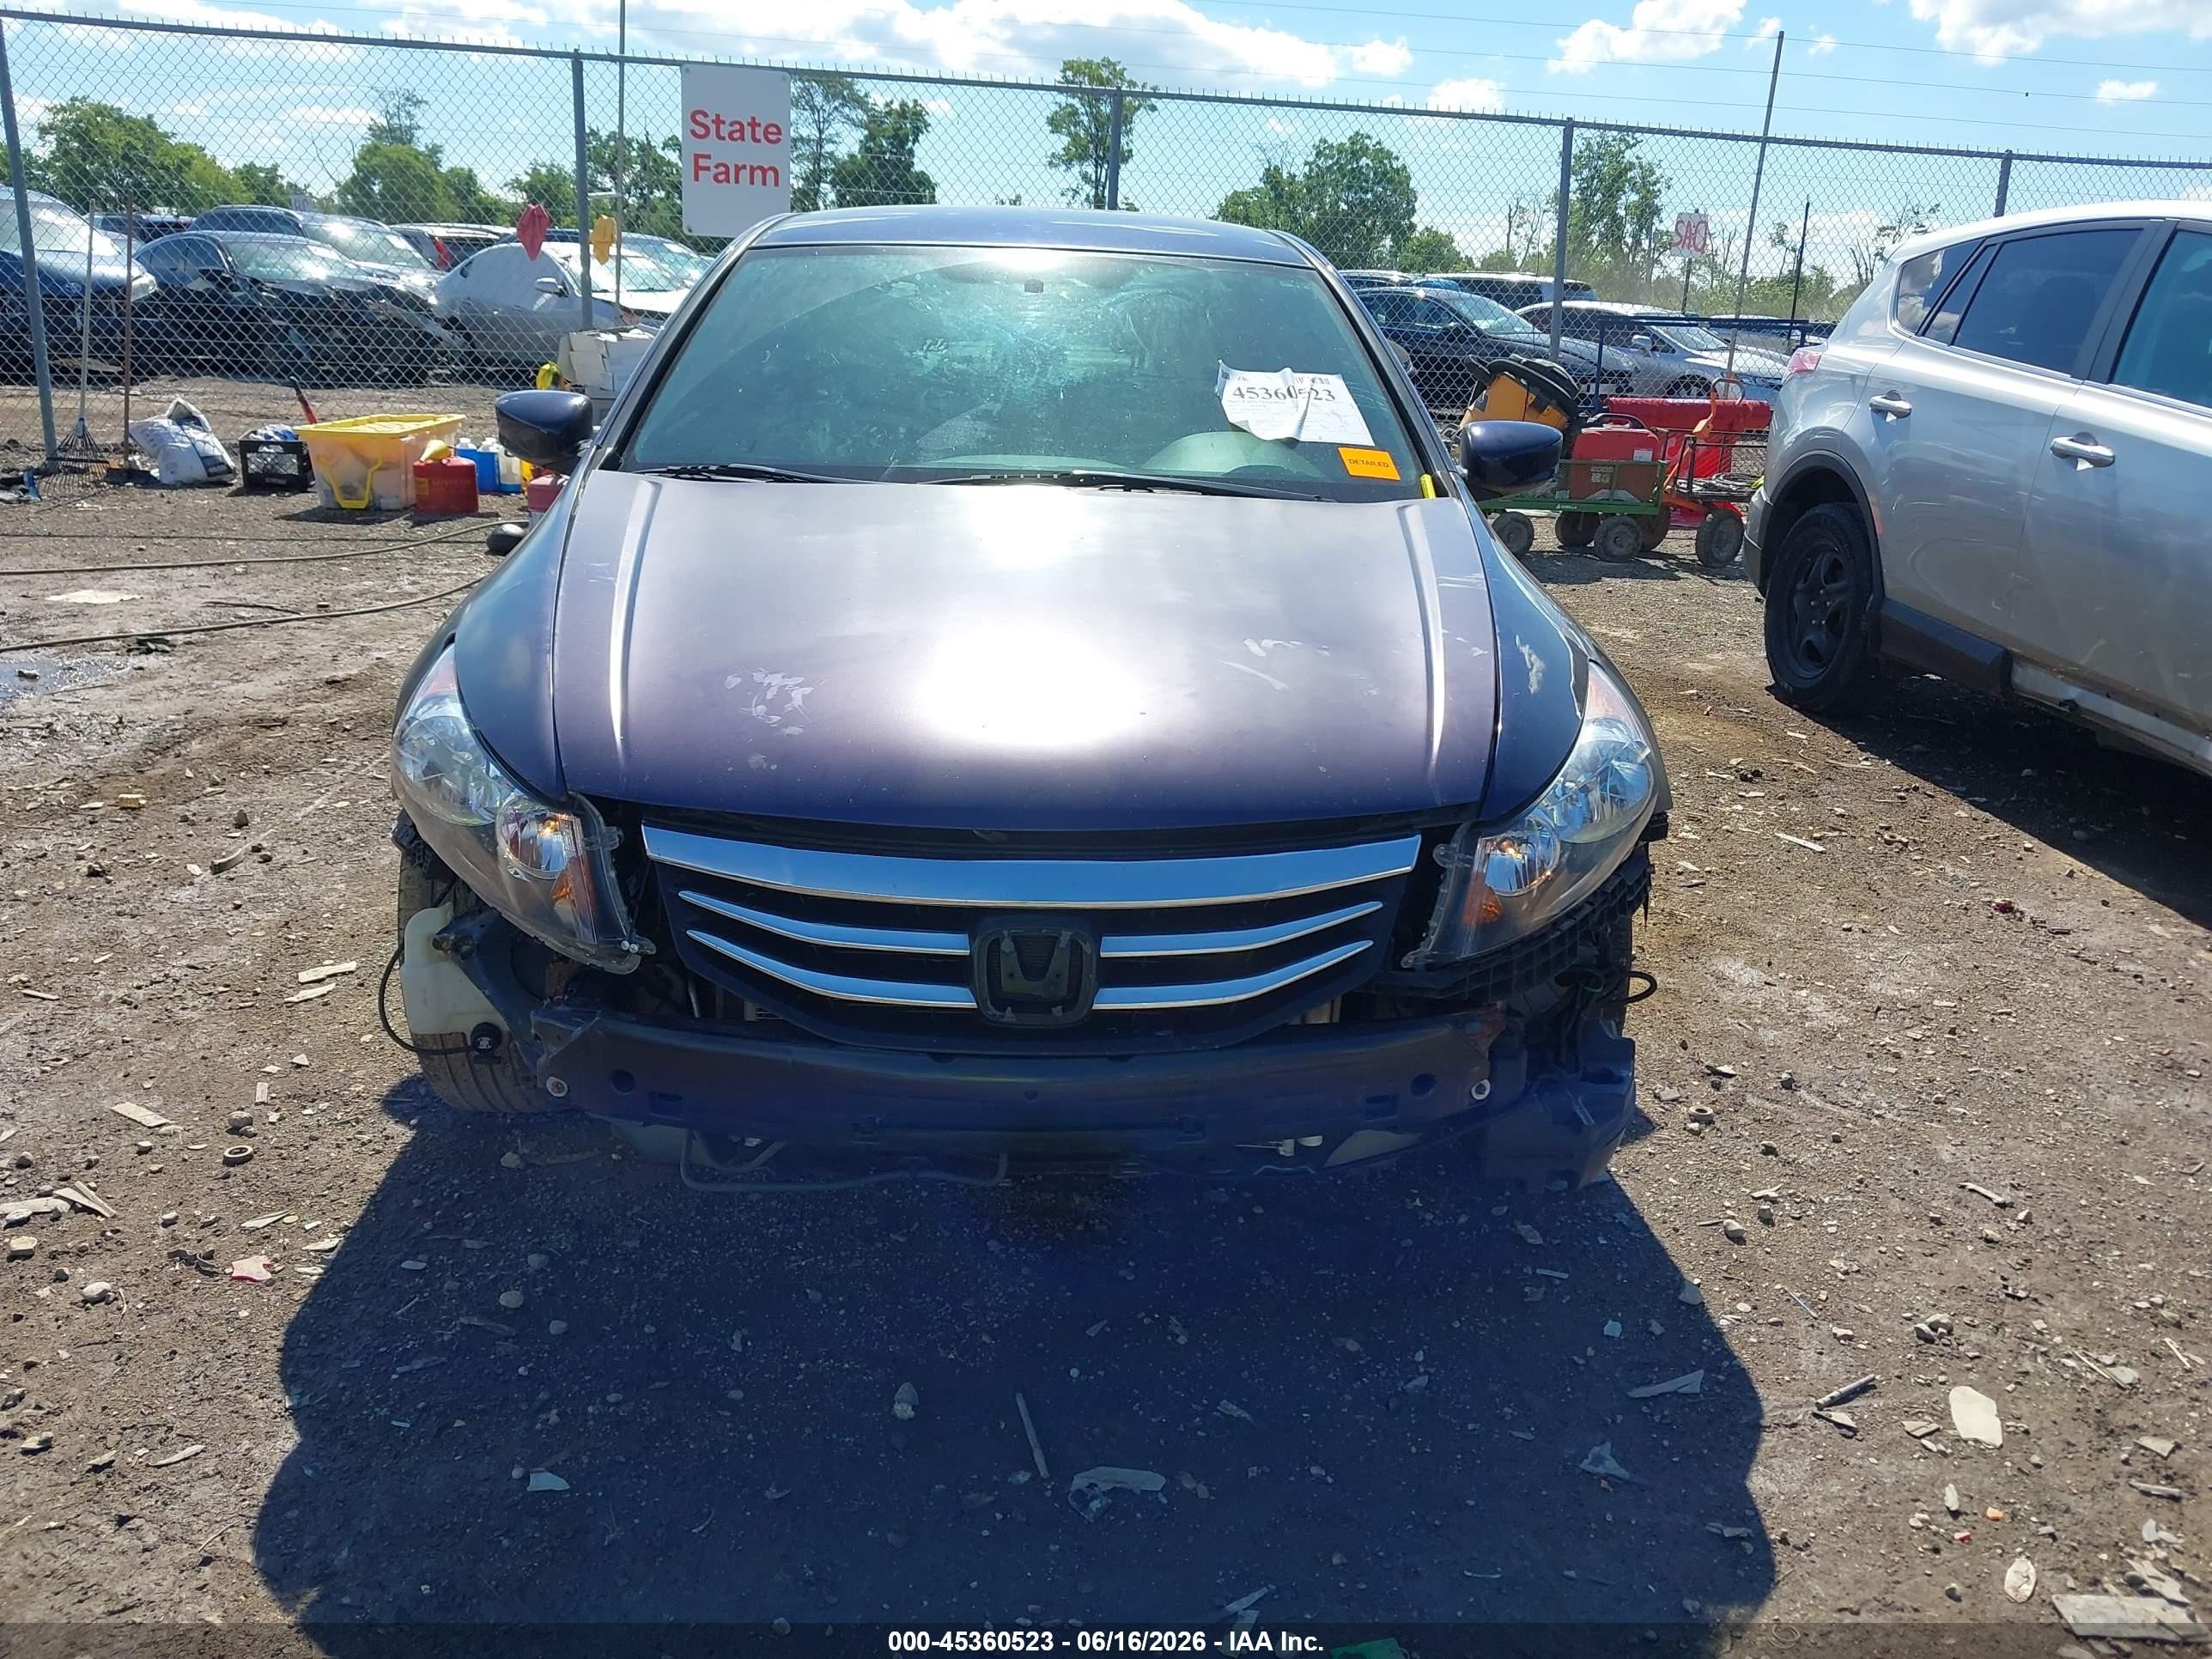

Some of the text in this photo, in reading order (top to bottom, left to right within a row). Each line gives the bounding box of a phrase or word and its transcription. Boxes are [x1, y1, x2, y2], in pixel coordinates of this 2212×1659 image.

[690, 109, 782, 145] State
[693, 153, 780, 187] Farm
[1348, 459, 1389, 468] DETAILED
